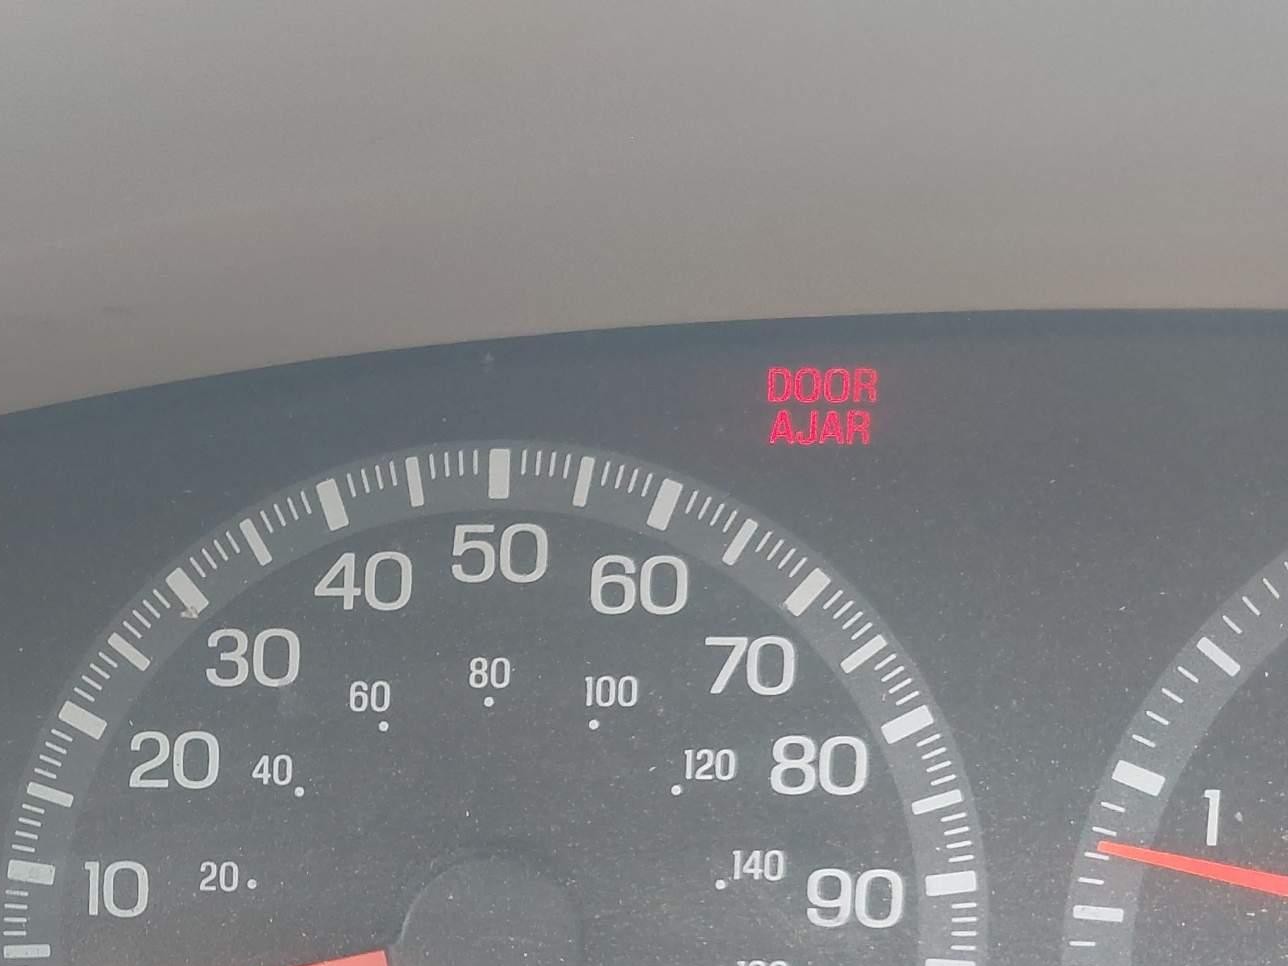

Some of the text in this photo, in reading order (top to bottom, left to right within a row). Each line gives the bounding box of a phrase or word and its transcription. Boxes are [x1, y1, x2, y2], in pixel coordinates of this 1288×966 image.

[767, 367, 879, 403] DOOR
[769, 409, 871, 445] AJAR
[314, 551, 413, 610] 40
[451, 522, 548, 583] 50
[589, 555, 689, 616] 60
[205, 627, 301, 687] 30
[467, 656, 511, 689] 80
[703, 635, 797, 695] 70
[348, 679, 391, 713] 60
[583, 675, 639, 709] 100
[127, 729, 221, 789] 20
[251, 753, 294, 786] 40
[683, 748, 737, 782] 120
[768, 734, 869, 795] 80
[1203, 789, 1221, 846] 1
[83, 858, 150, 918] 10
[199, 861, 240, 893] 20
[731, 849, 786, 882] 140
[805, 867, 904, 928] 90
